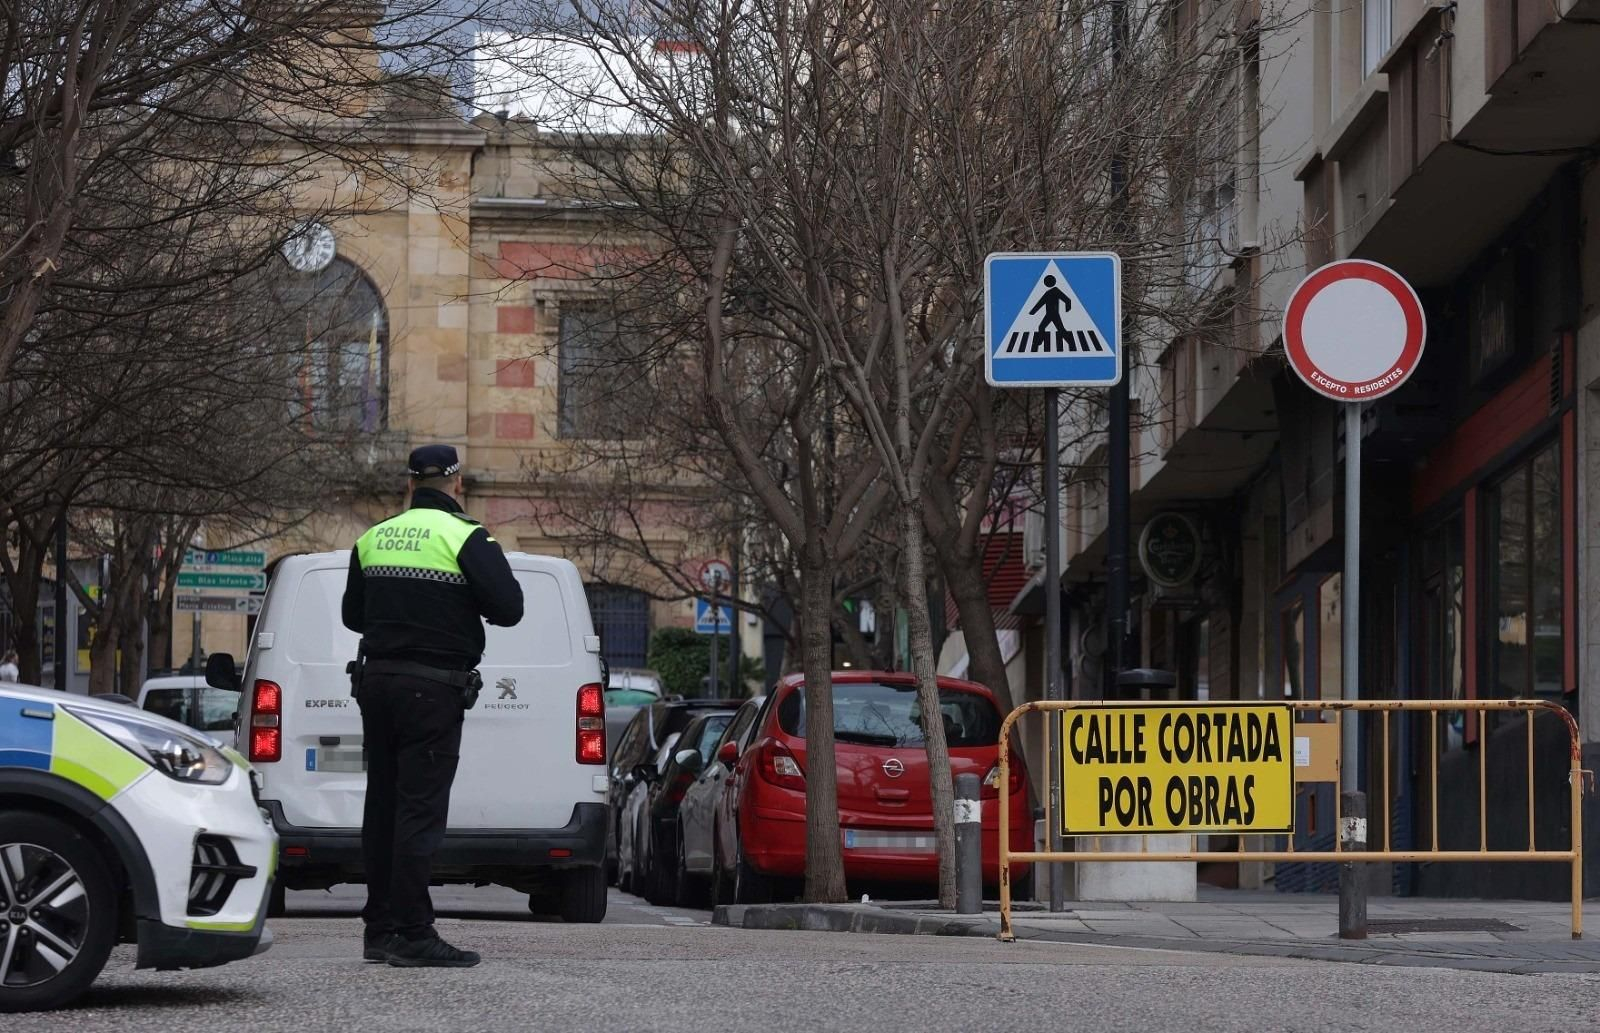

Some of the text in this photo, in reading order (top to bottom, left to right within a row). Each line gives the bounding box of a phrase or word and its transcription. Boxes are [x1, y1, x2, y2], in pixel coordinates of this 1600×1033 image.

[1311, 367, 1403, 394] EXCEPTO RESIDENTES
[375, 526, 430, 539] POLICIA
[376, 539, 421, 551] LOCAL
[305, 699, 349, 708] EXPERT
[1069, 712, 1282, 764] CALLE CORTADA
[1098, 774, 1256, 827] POR OBRAS
